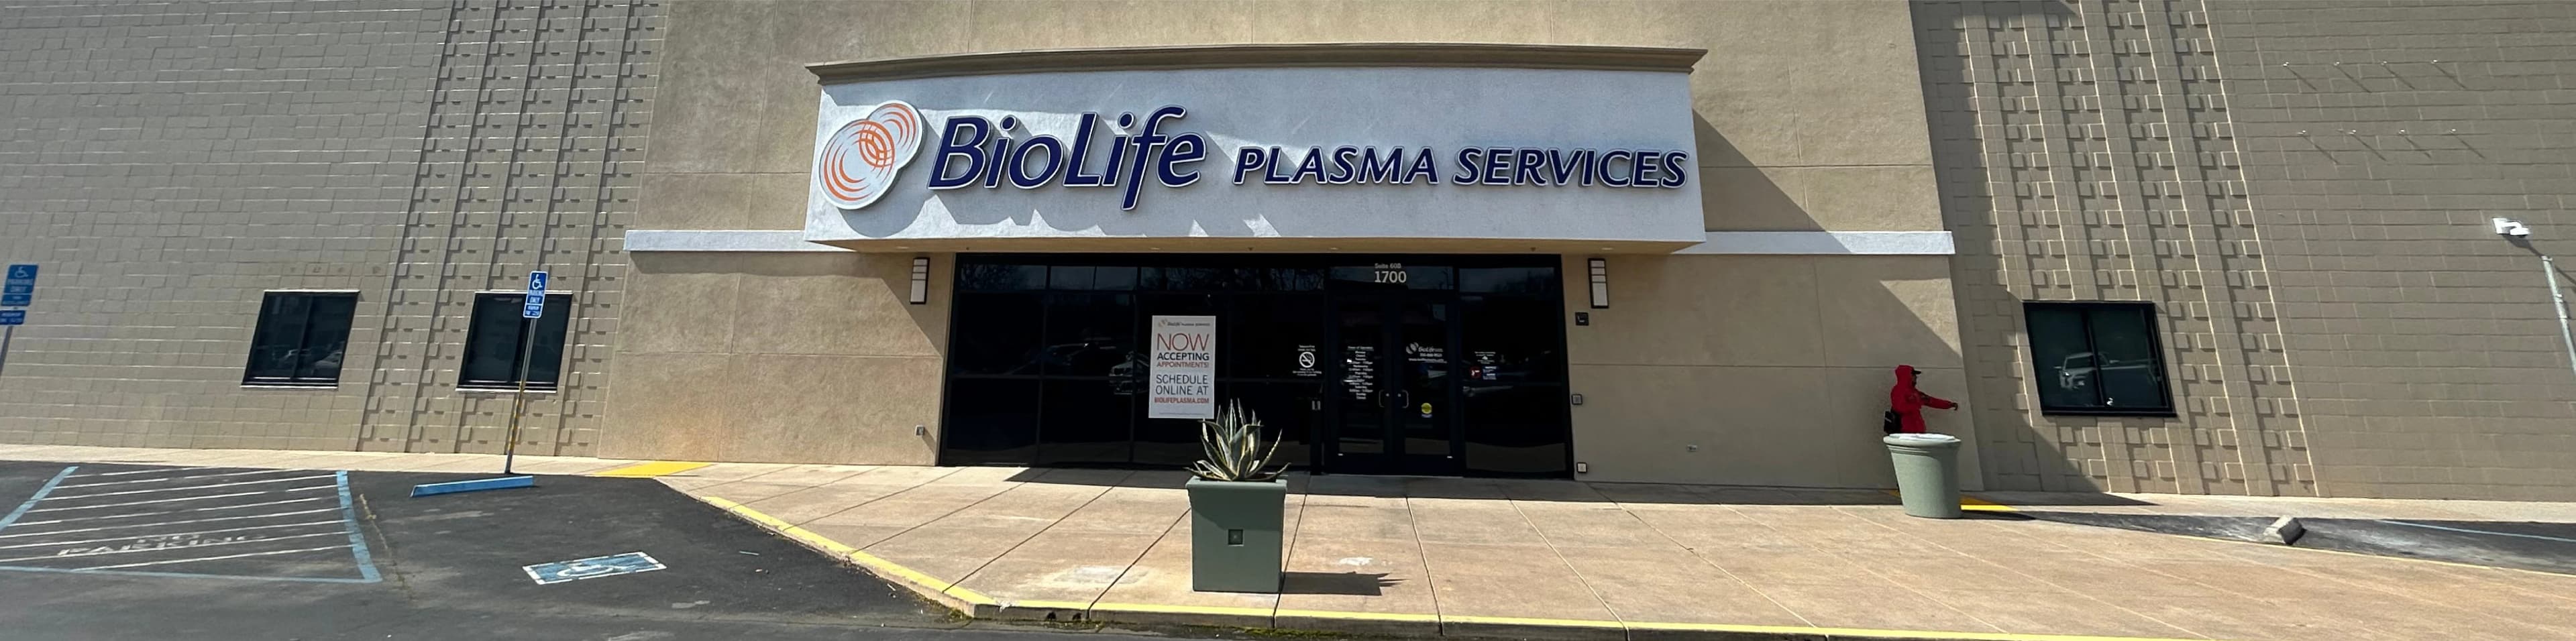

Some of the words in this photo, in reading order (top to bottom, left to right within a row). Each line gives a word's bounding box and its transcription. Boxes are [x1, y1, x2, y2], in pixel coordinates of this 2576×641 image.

[927, 105, 1207, 211] BioLife
[1233, 145, 1440, 184] PLASMA
[1452, 147, 1689, 189] SERVICES
[1375, 271, 1407, 283] 1700
[1157, 333, 1210, 351] NOW
[1157, 352, 1210, 361] ACCEPTING
[1156, 374, 1208, 384] SCHEDULE
[1155, 385, 1193, 396] ONLINE
[1196, 386, 1209, 396] AT
